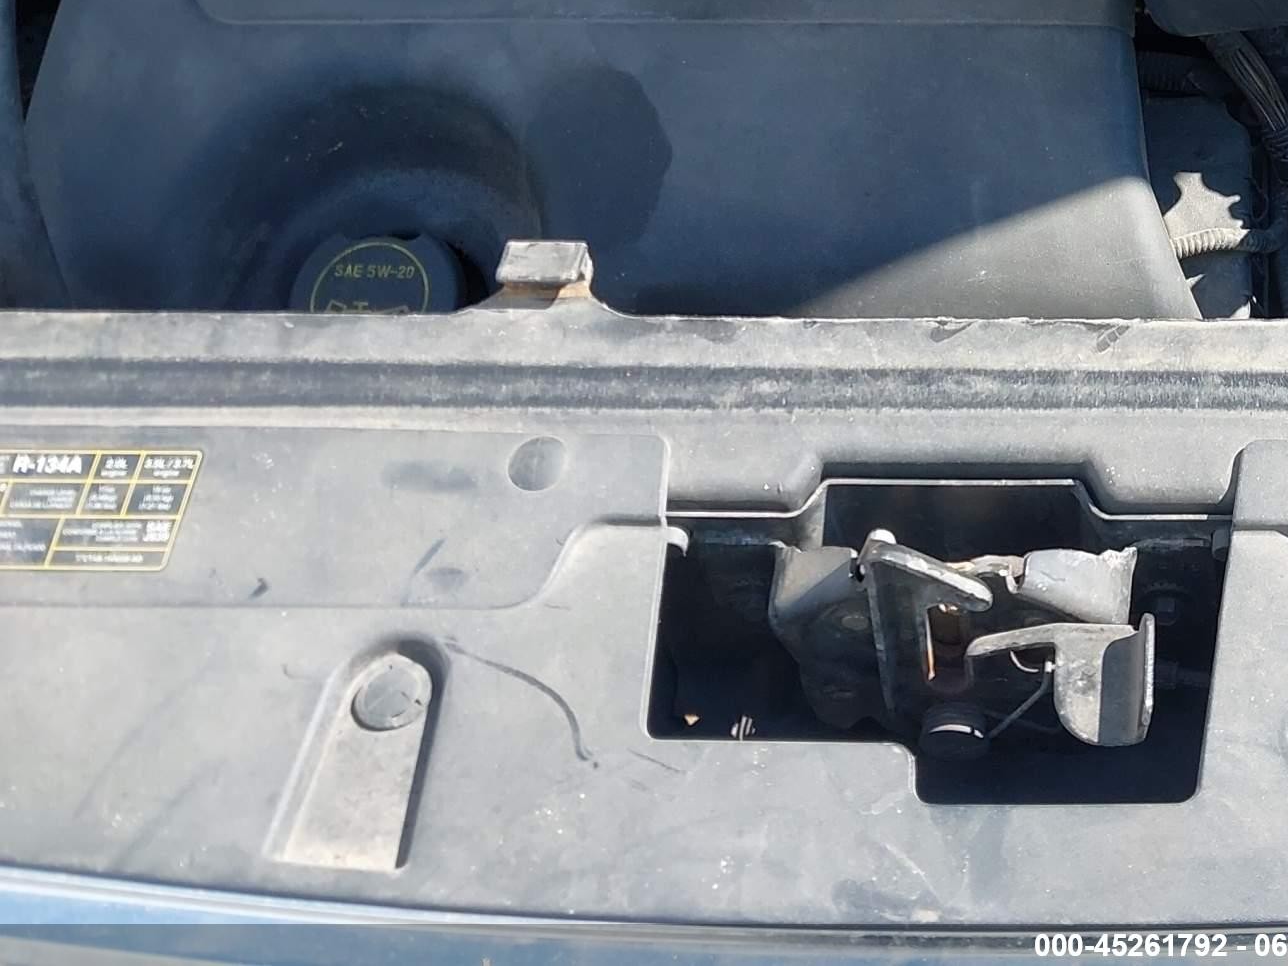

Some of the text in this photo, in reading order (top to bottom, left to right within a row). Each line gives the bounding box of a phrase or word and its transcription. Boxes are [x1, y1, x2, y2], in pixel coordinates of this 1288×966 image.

[333, 264, 415, 279] SAE 5W-20
[12, 453, 82, 474] R-134A
